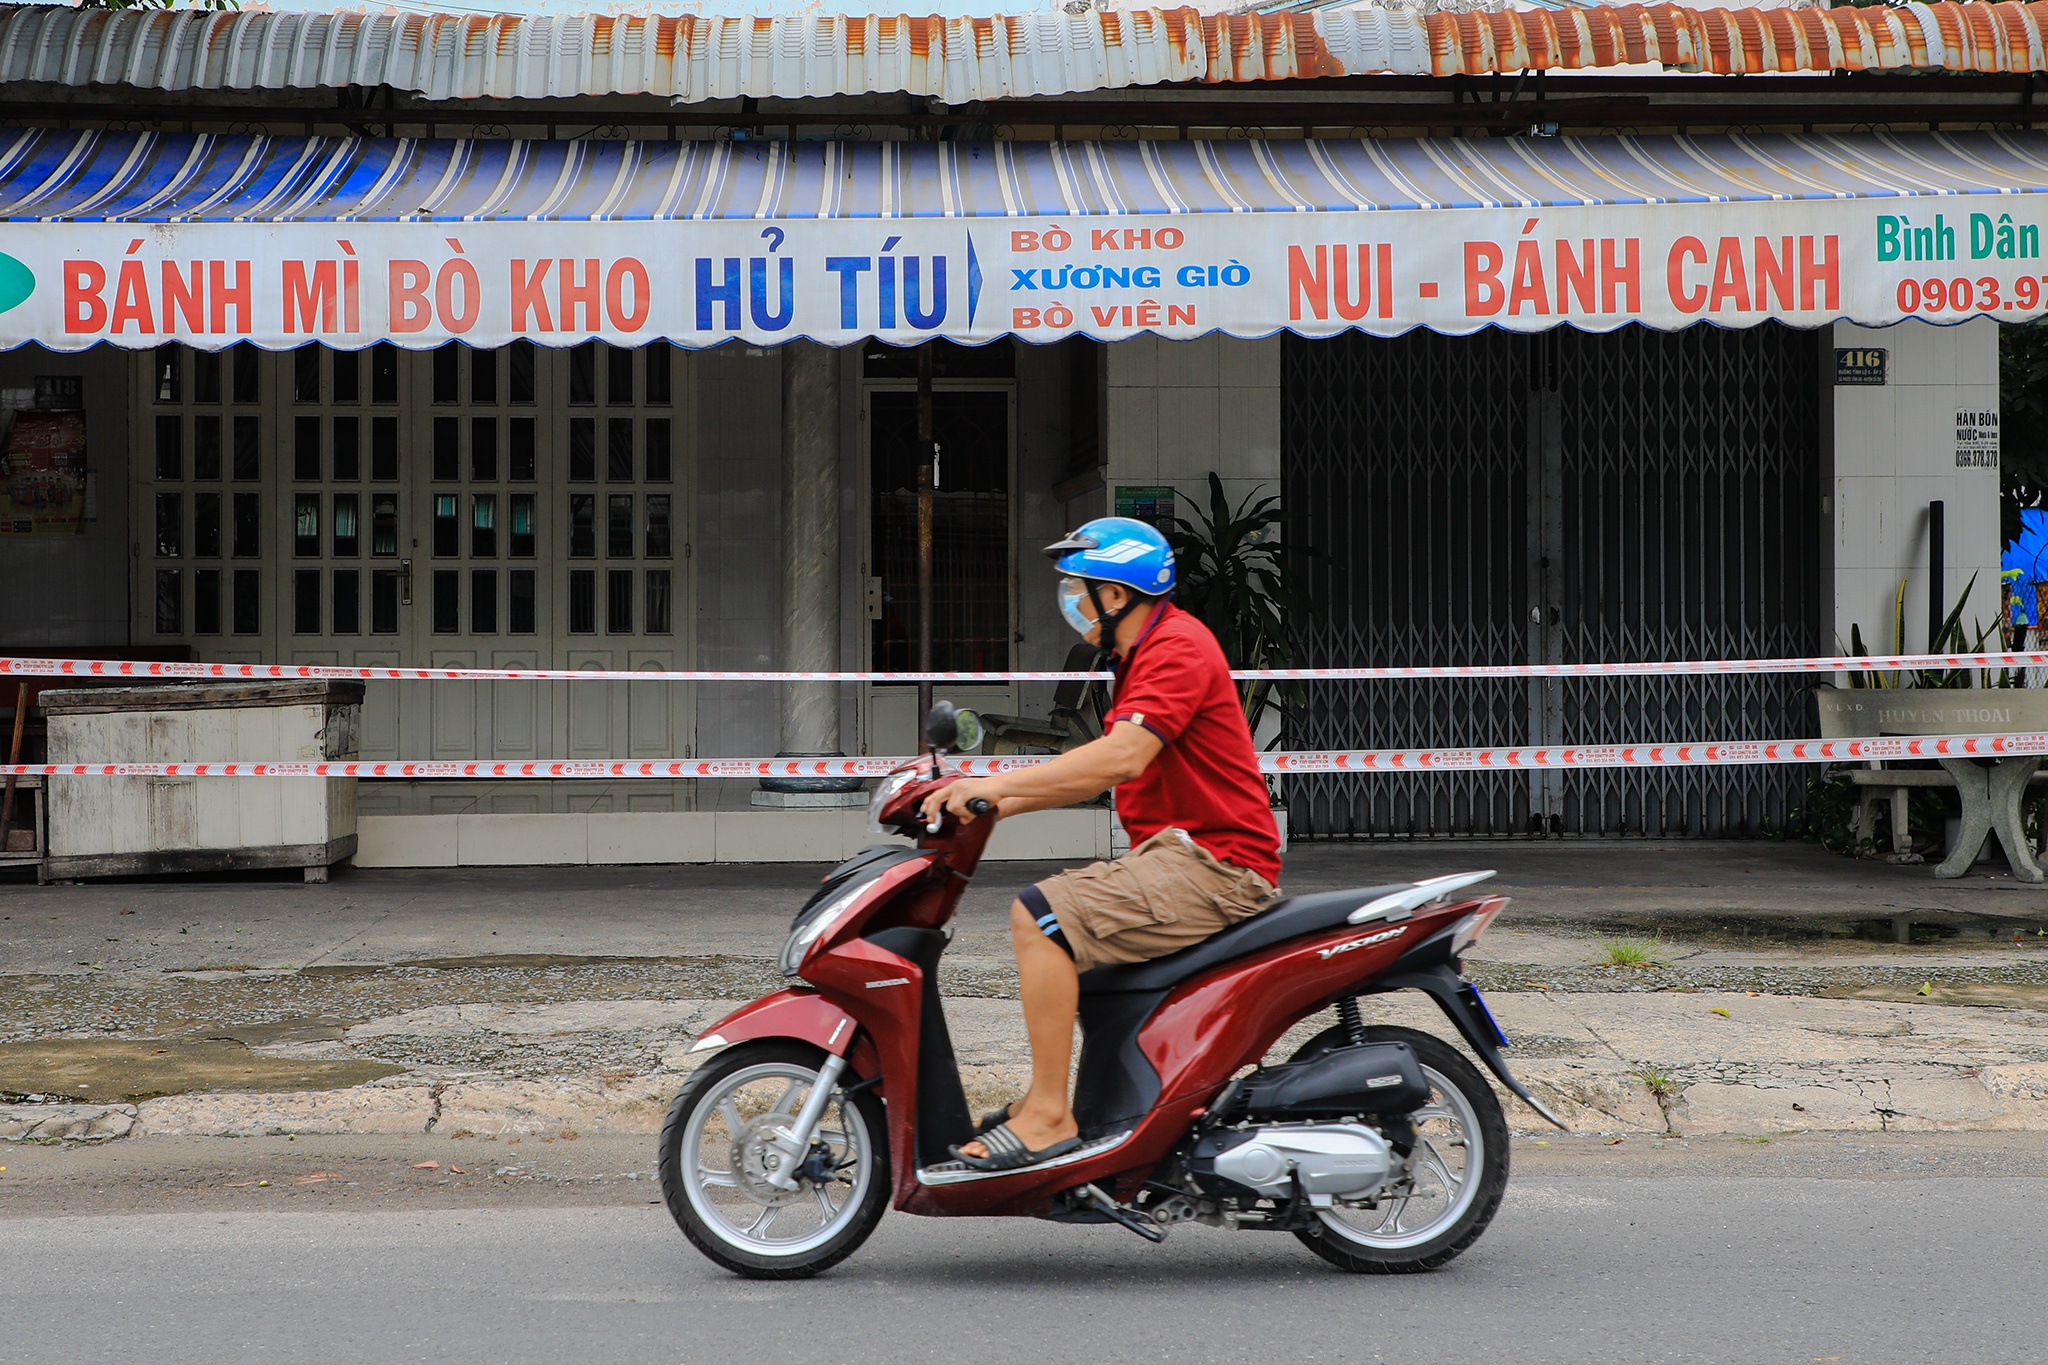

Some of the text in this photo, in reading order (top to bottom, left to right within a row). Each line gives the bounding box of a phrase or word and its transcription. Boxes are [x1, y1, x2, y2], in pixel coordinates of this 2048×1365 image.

[1011, 224, 1184, 252] BÒ KHO
[1877, 213, 2040, 261] Bình Dân
[695, 226, 947, 331] HỦ TÍU
[1010, 259, 1251, 290] XƯƠNG GIÒ
[1288, 243, 1393, 320] NUI
[1463, 218, 1641, 317] BÁNH
[1666, 234, 1841, 314] CANH
[63, 238, 651, 335] BÁNH MÌ BÒ KHO
[1012, 299, 1196, 329] BÒ VIÊN
[1840, 351, 1880, 368] 416
[41, 379, 76, 395] 418
[1956, 409, 1976, 426] HÀN
[1316, 925, 1408, 960] VISION
